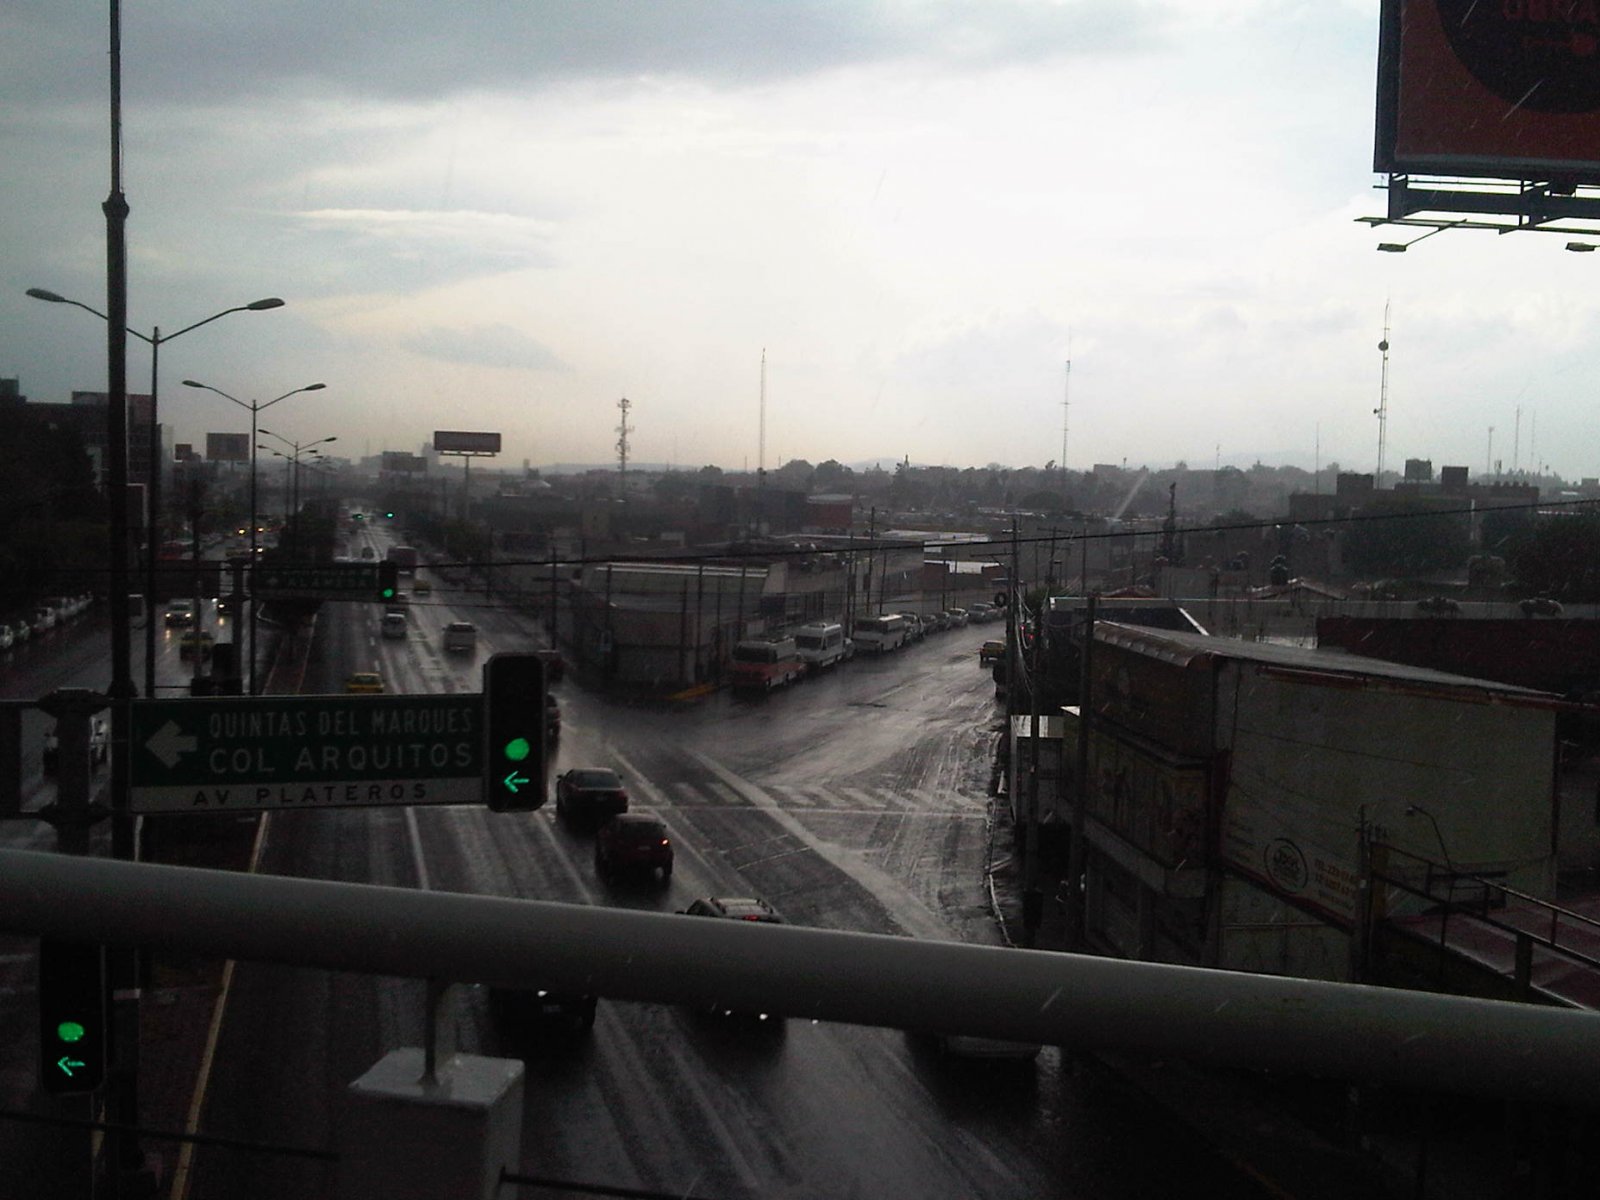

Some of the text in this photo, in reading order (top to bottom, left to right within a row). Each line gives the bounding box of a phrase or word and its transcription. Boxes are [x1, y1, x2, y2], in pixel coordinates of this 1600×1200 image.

[208, 711, 306, 739] QUINTAS
[319, 710, 360, 736] DEL
[208, 743, 473, 774] COL ARQUITOS
[194, 783, 427, 806] AV PLATEROS
